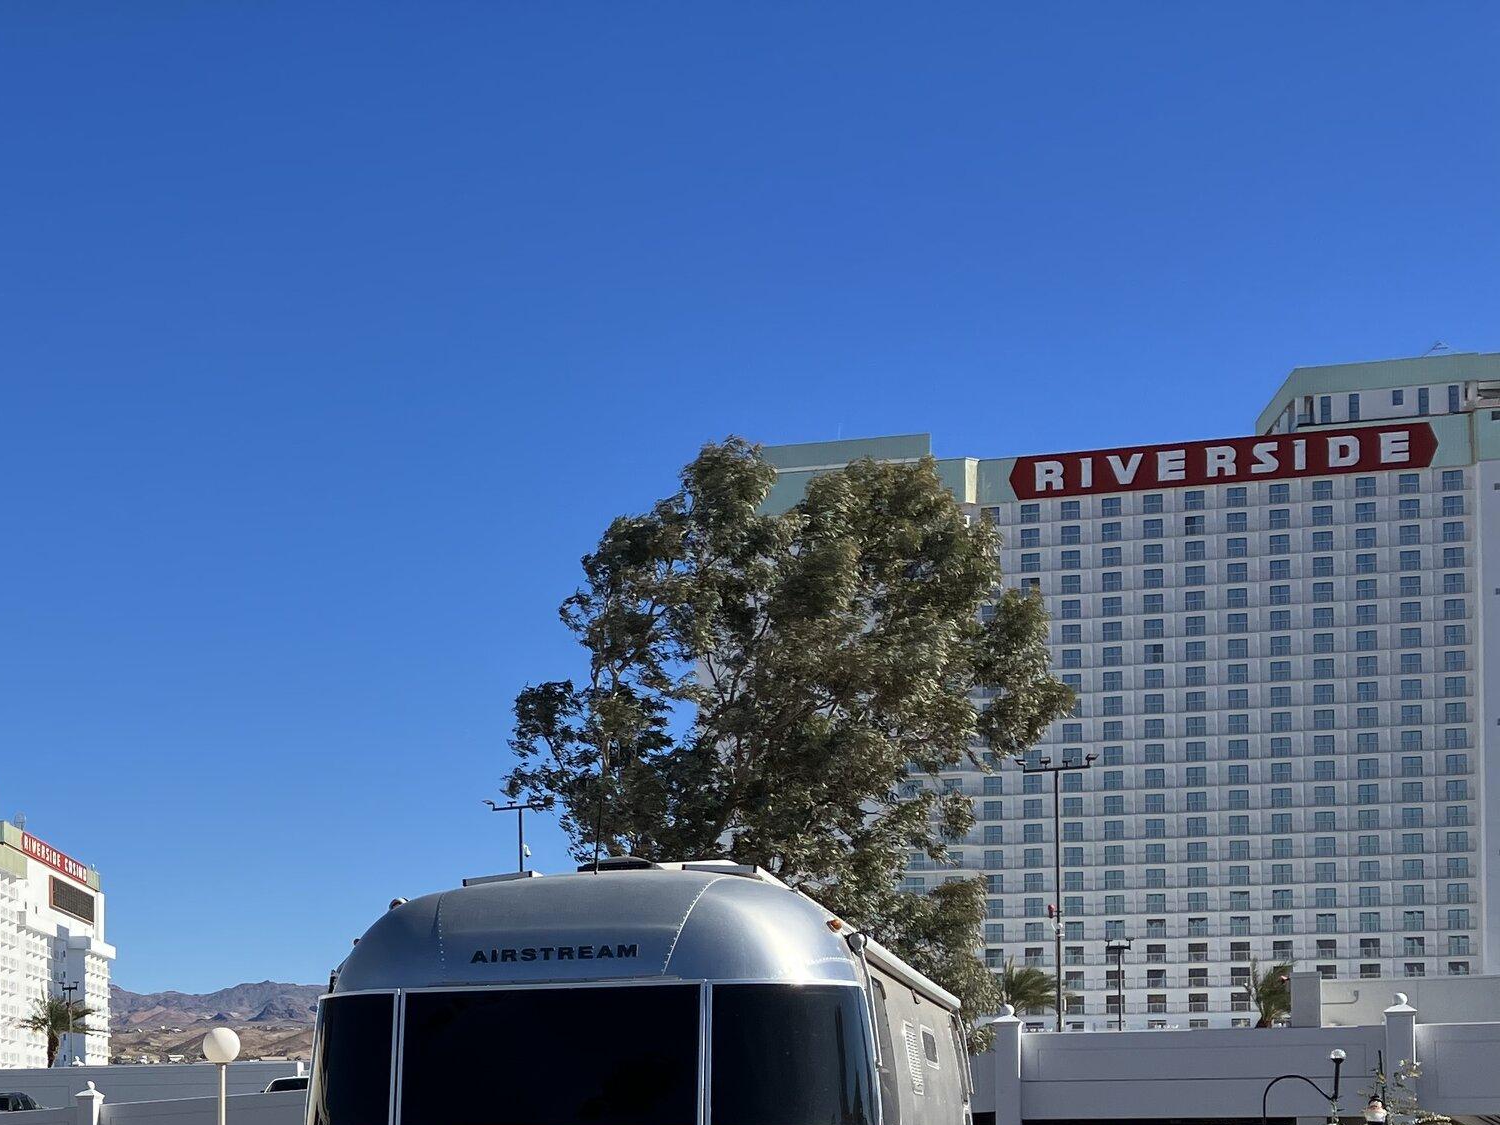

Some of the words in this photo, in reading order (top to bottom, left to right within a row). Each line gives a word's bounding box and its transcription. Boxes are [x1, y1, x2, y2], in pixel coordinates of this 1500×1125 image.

[1034, 430, 1410, 492] RIVERSIDE
[23, 834, 61, 868] RIVERSIDE
[64, 857, 87, 882] CASINO
[470, 944, 639, 964] AIRSTREAM
